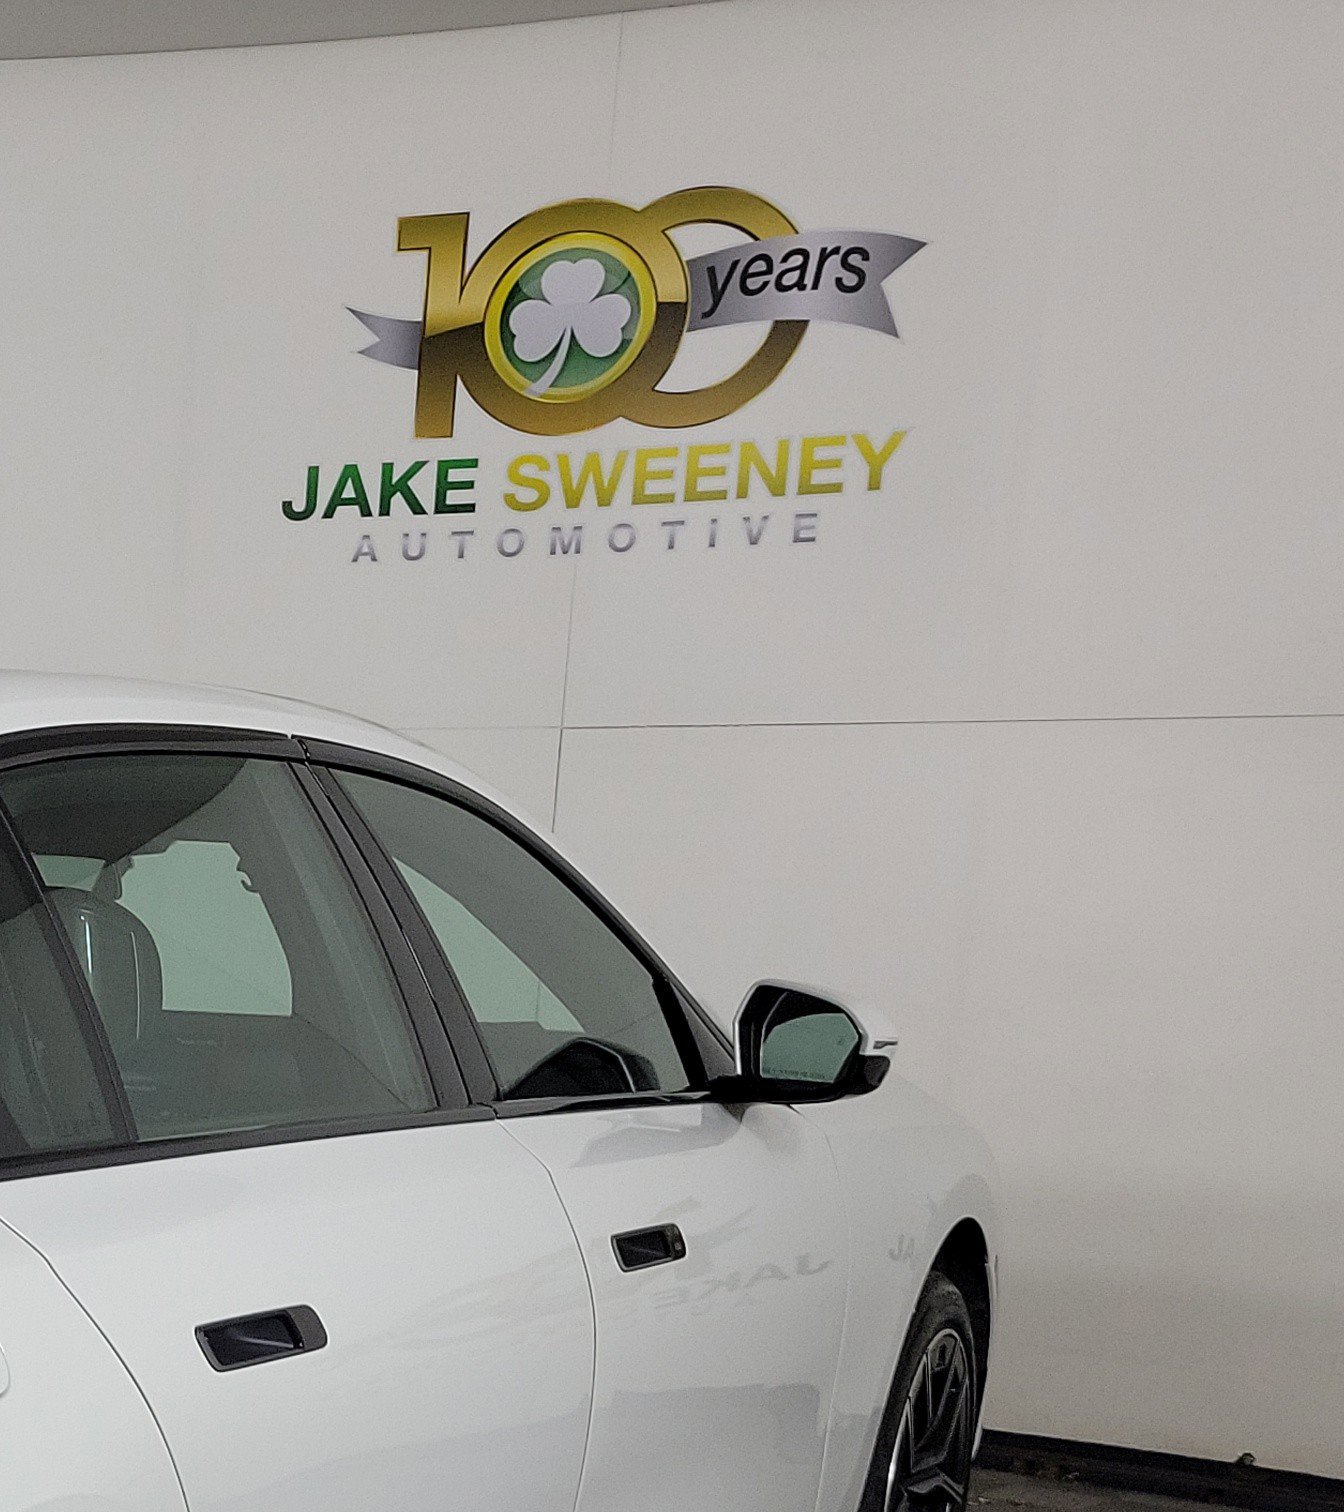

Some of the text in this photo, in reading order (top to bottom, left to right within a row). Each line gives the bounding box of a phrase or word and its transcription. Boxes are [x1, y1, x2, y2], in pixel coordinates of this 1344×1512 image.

[397, 185, 811, 439] 100
[700, 243, 871, 319] years
[281, 430, 907, 522] JAKE SWEENEY
[351, 512, 819, 564] AUTOMOTIVE
